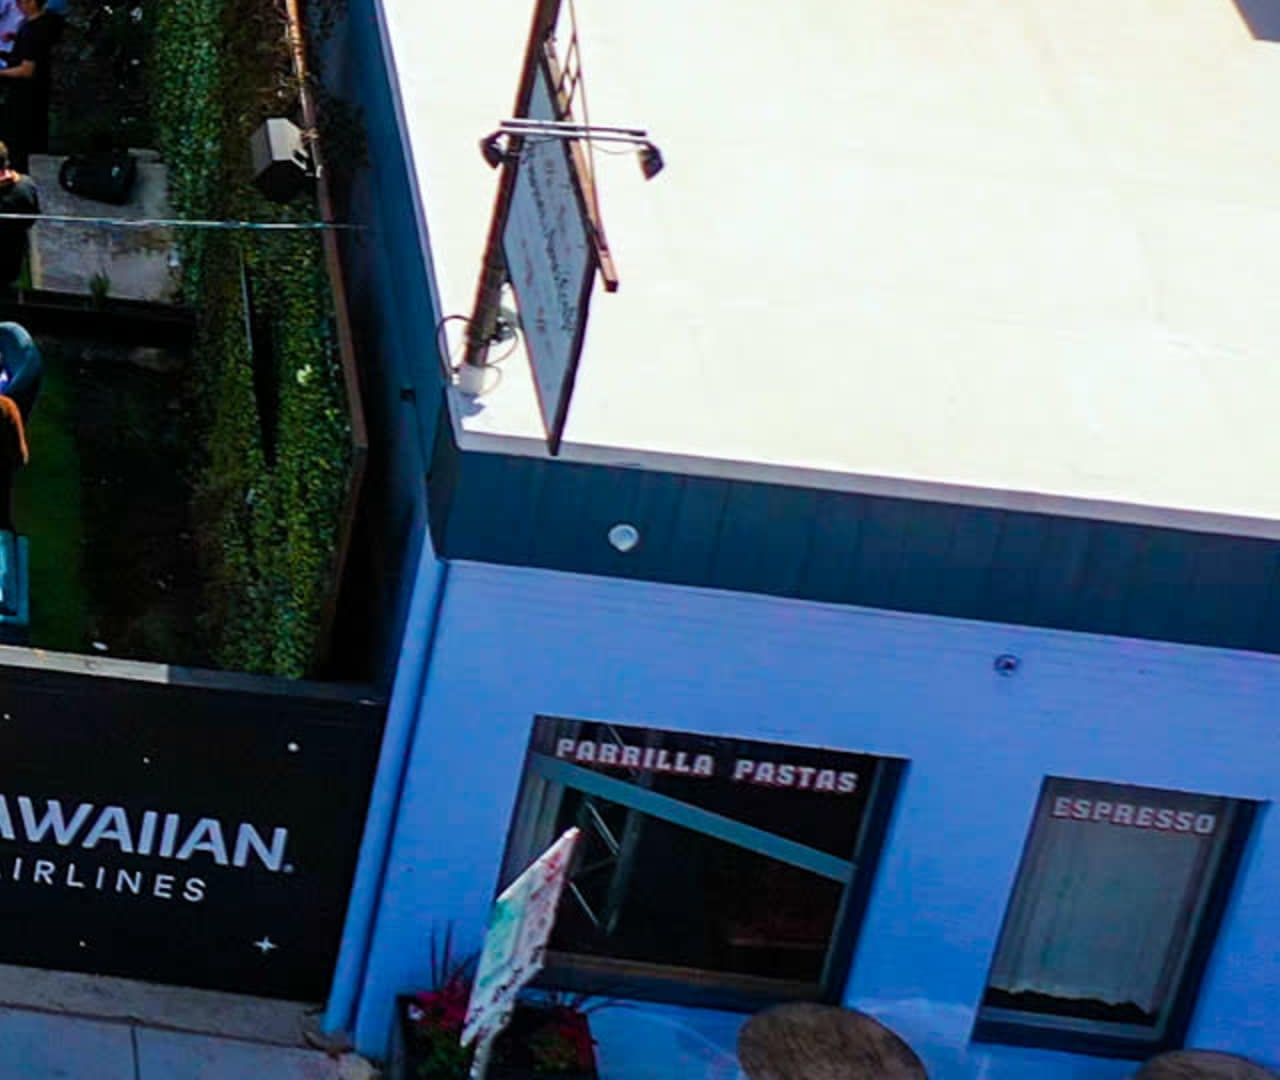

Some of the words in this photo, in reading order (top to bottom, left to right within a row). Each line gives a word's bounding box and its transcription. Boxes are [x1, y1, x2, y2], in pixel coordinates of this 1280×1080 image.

[555, 737, 716, 776] PARRILLA
[733, 758, 859, 794] PASTAS
[1051, 795, 1218, 836] ESPRESSO
